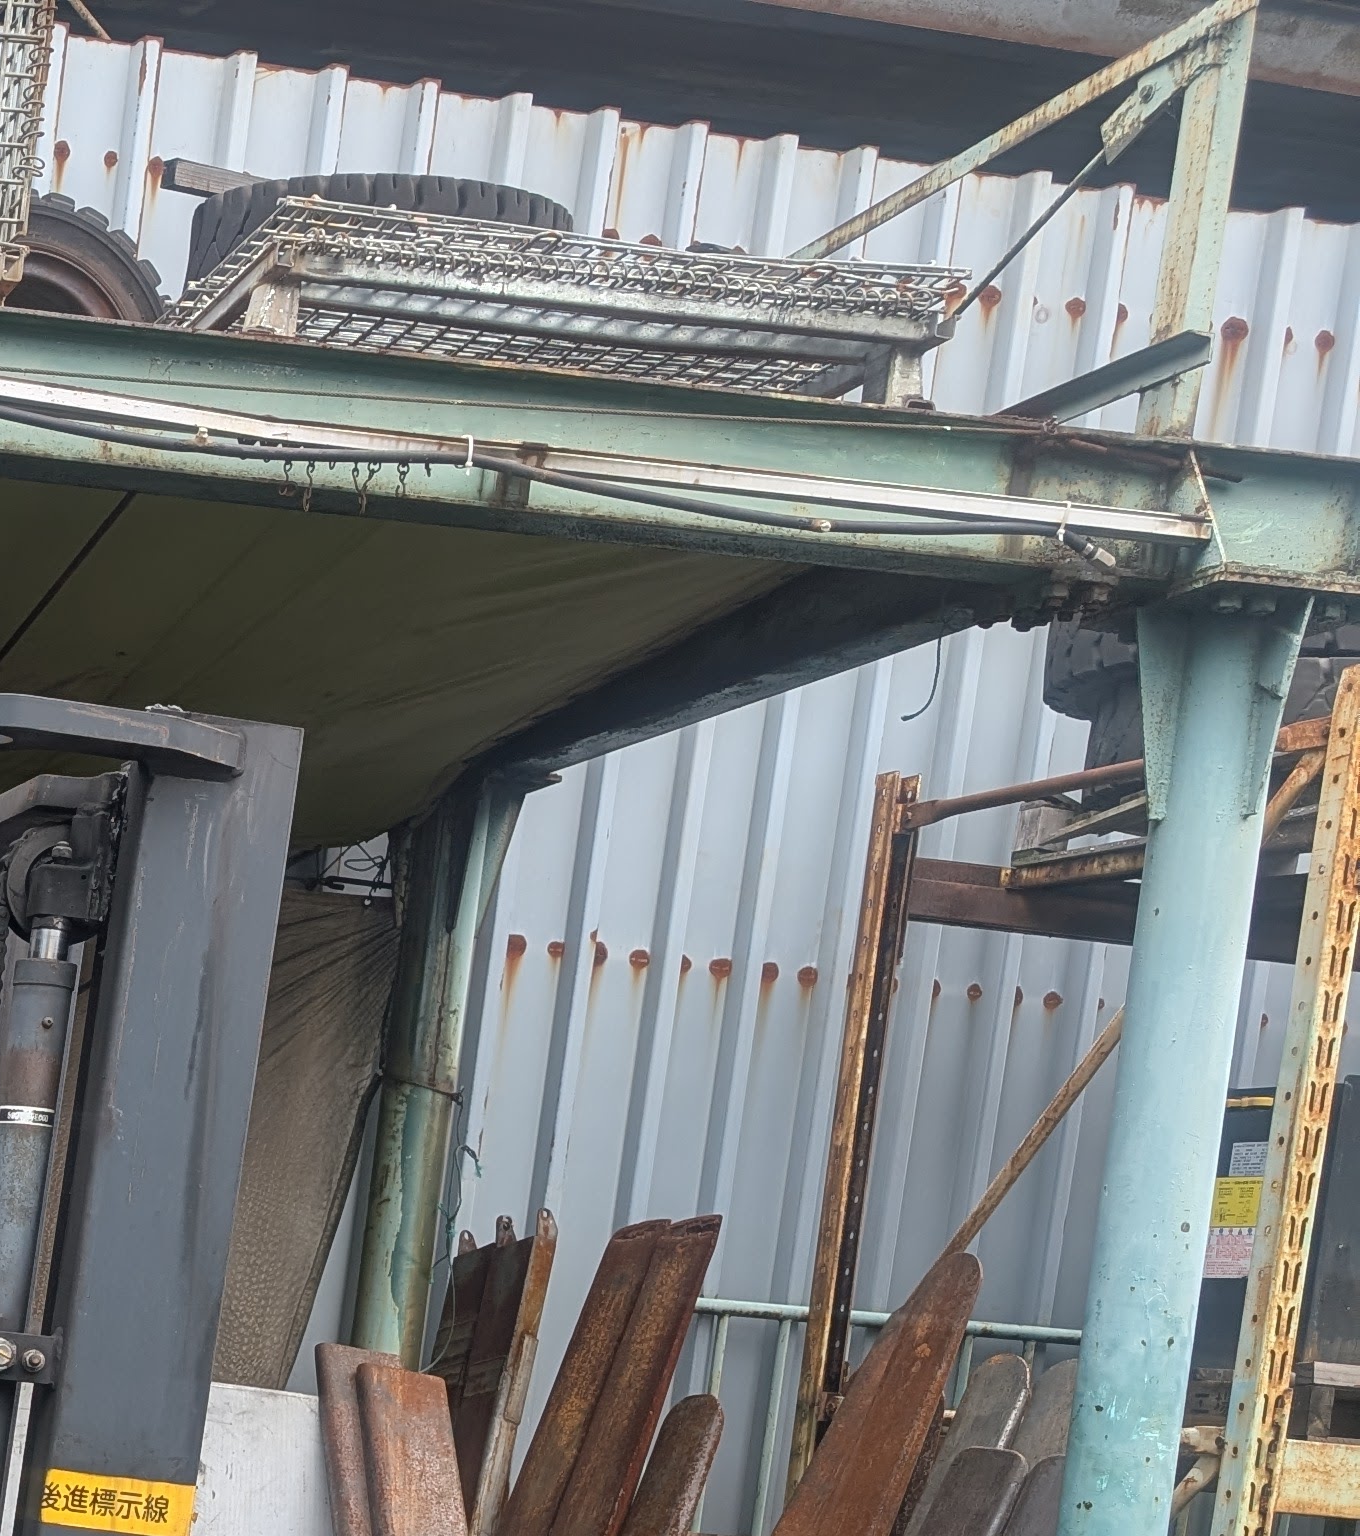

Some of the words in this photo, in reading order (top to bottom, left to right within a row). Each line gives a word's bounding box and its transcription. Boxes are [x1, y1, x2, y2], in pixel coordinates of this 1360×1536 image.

[40, 1482, 170, 1524] 後進標示線
